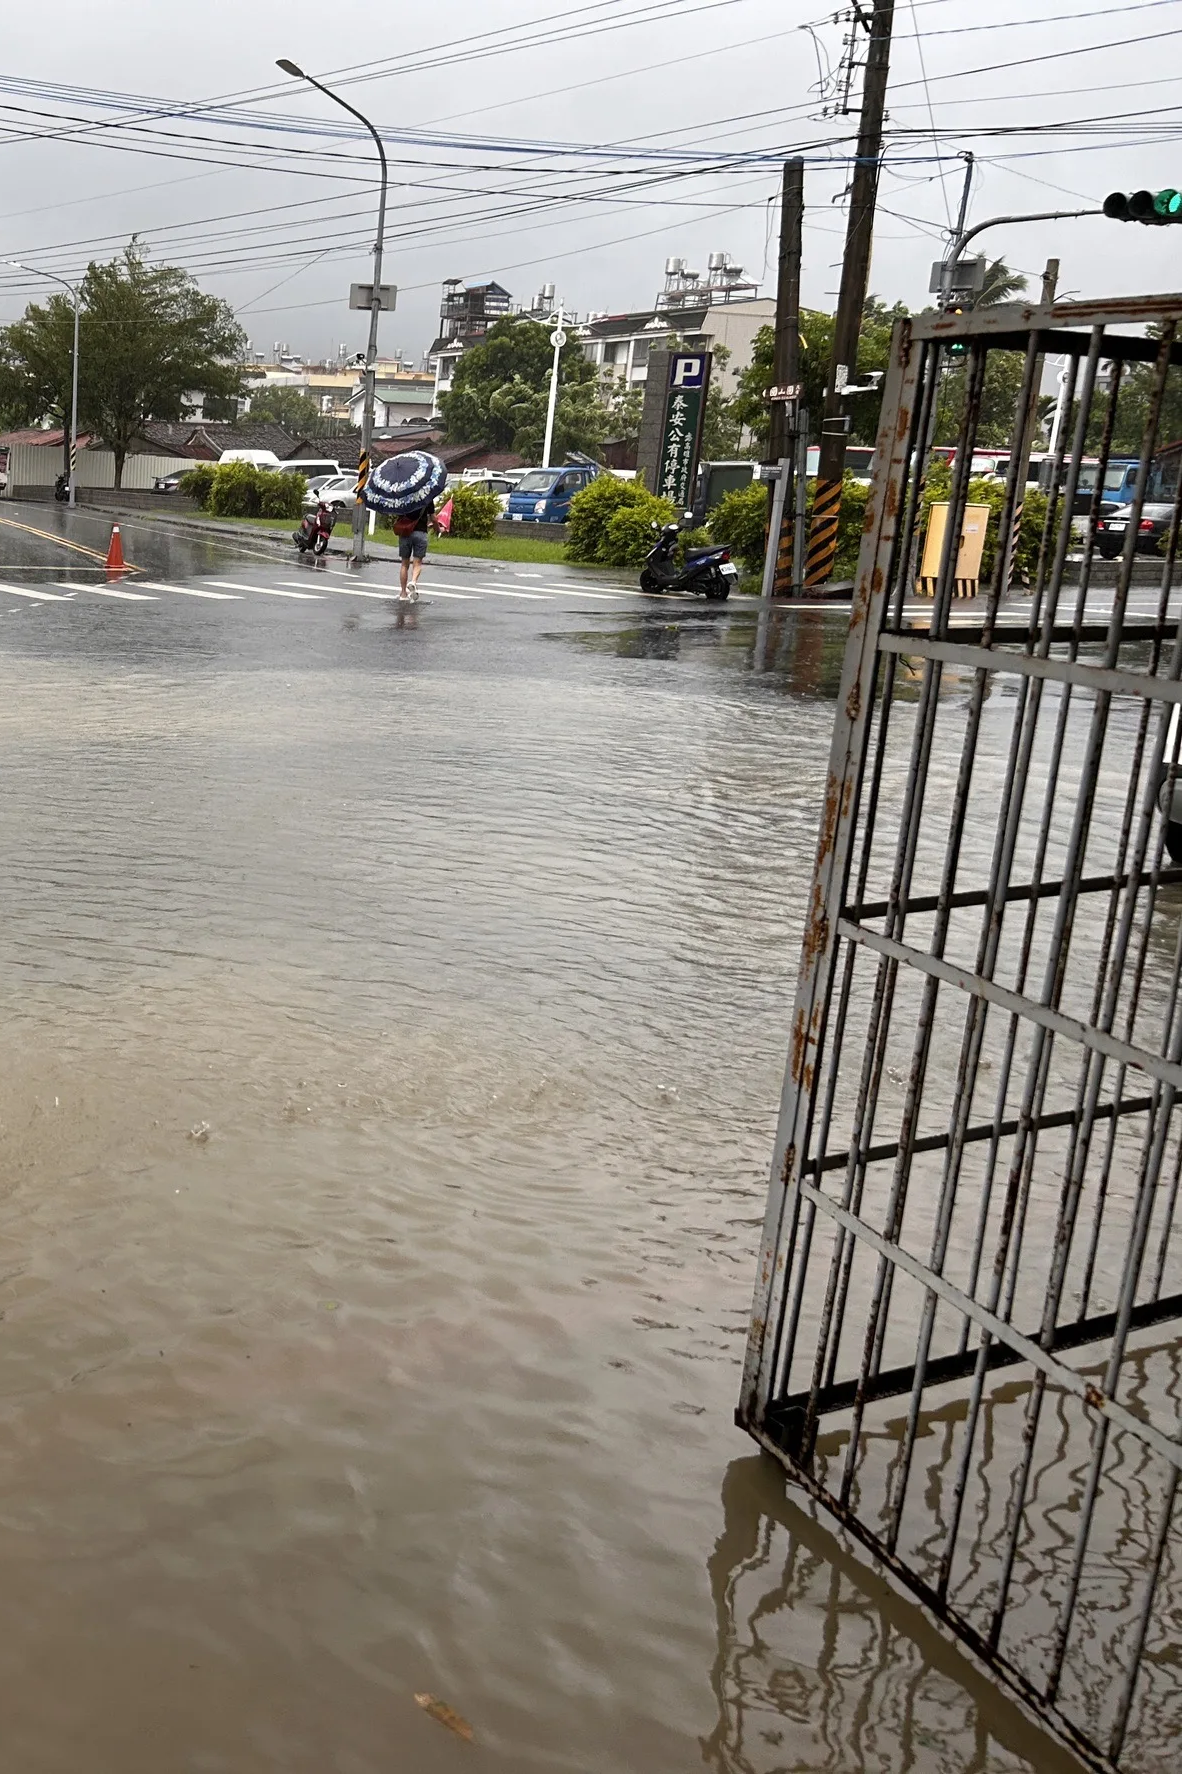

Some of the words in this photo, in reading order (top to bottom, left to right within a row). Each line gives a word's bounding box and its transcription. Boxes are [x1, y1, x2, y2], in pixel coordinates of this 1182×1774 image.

[672, 358, 701, 386] P
[660, 395, 689, 506] 泰安公有停車場
